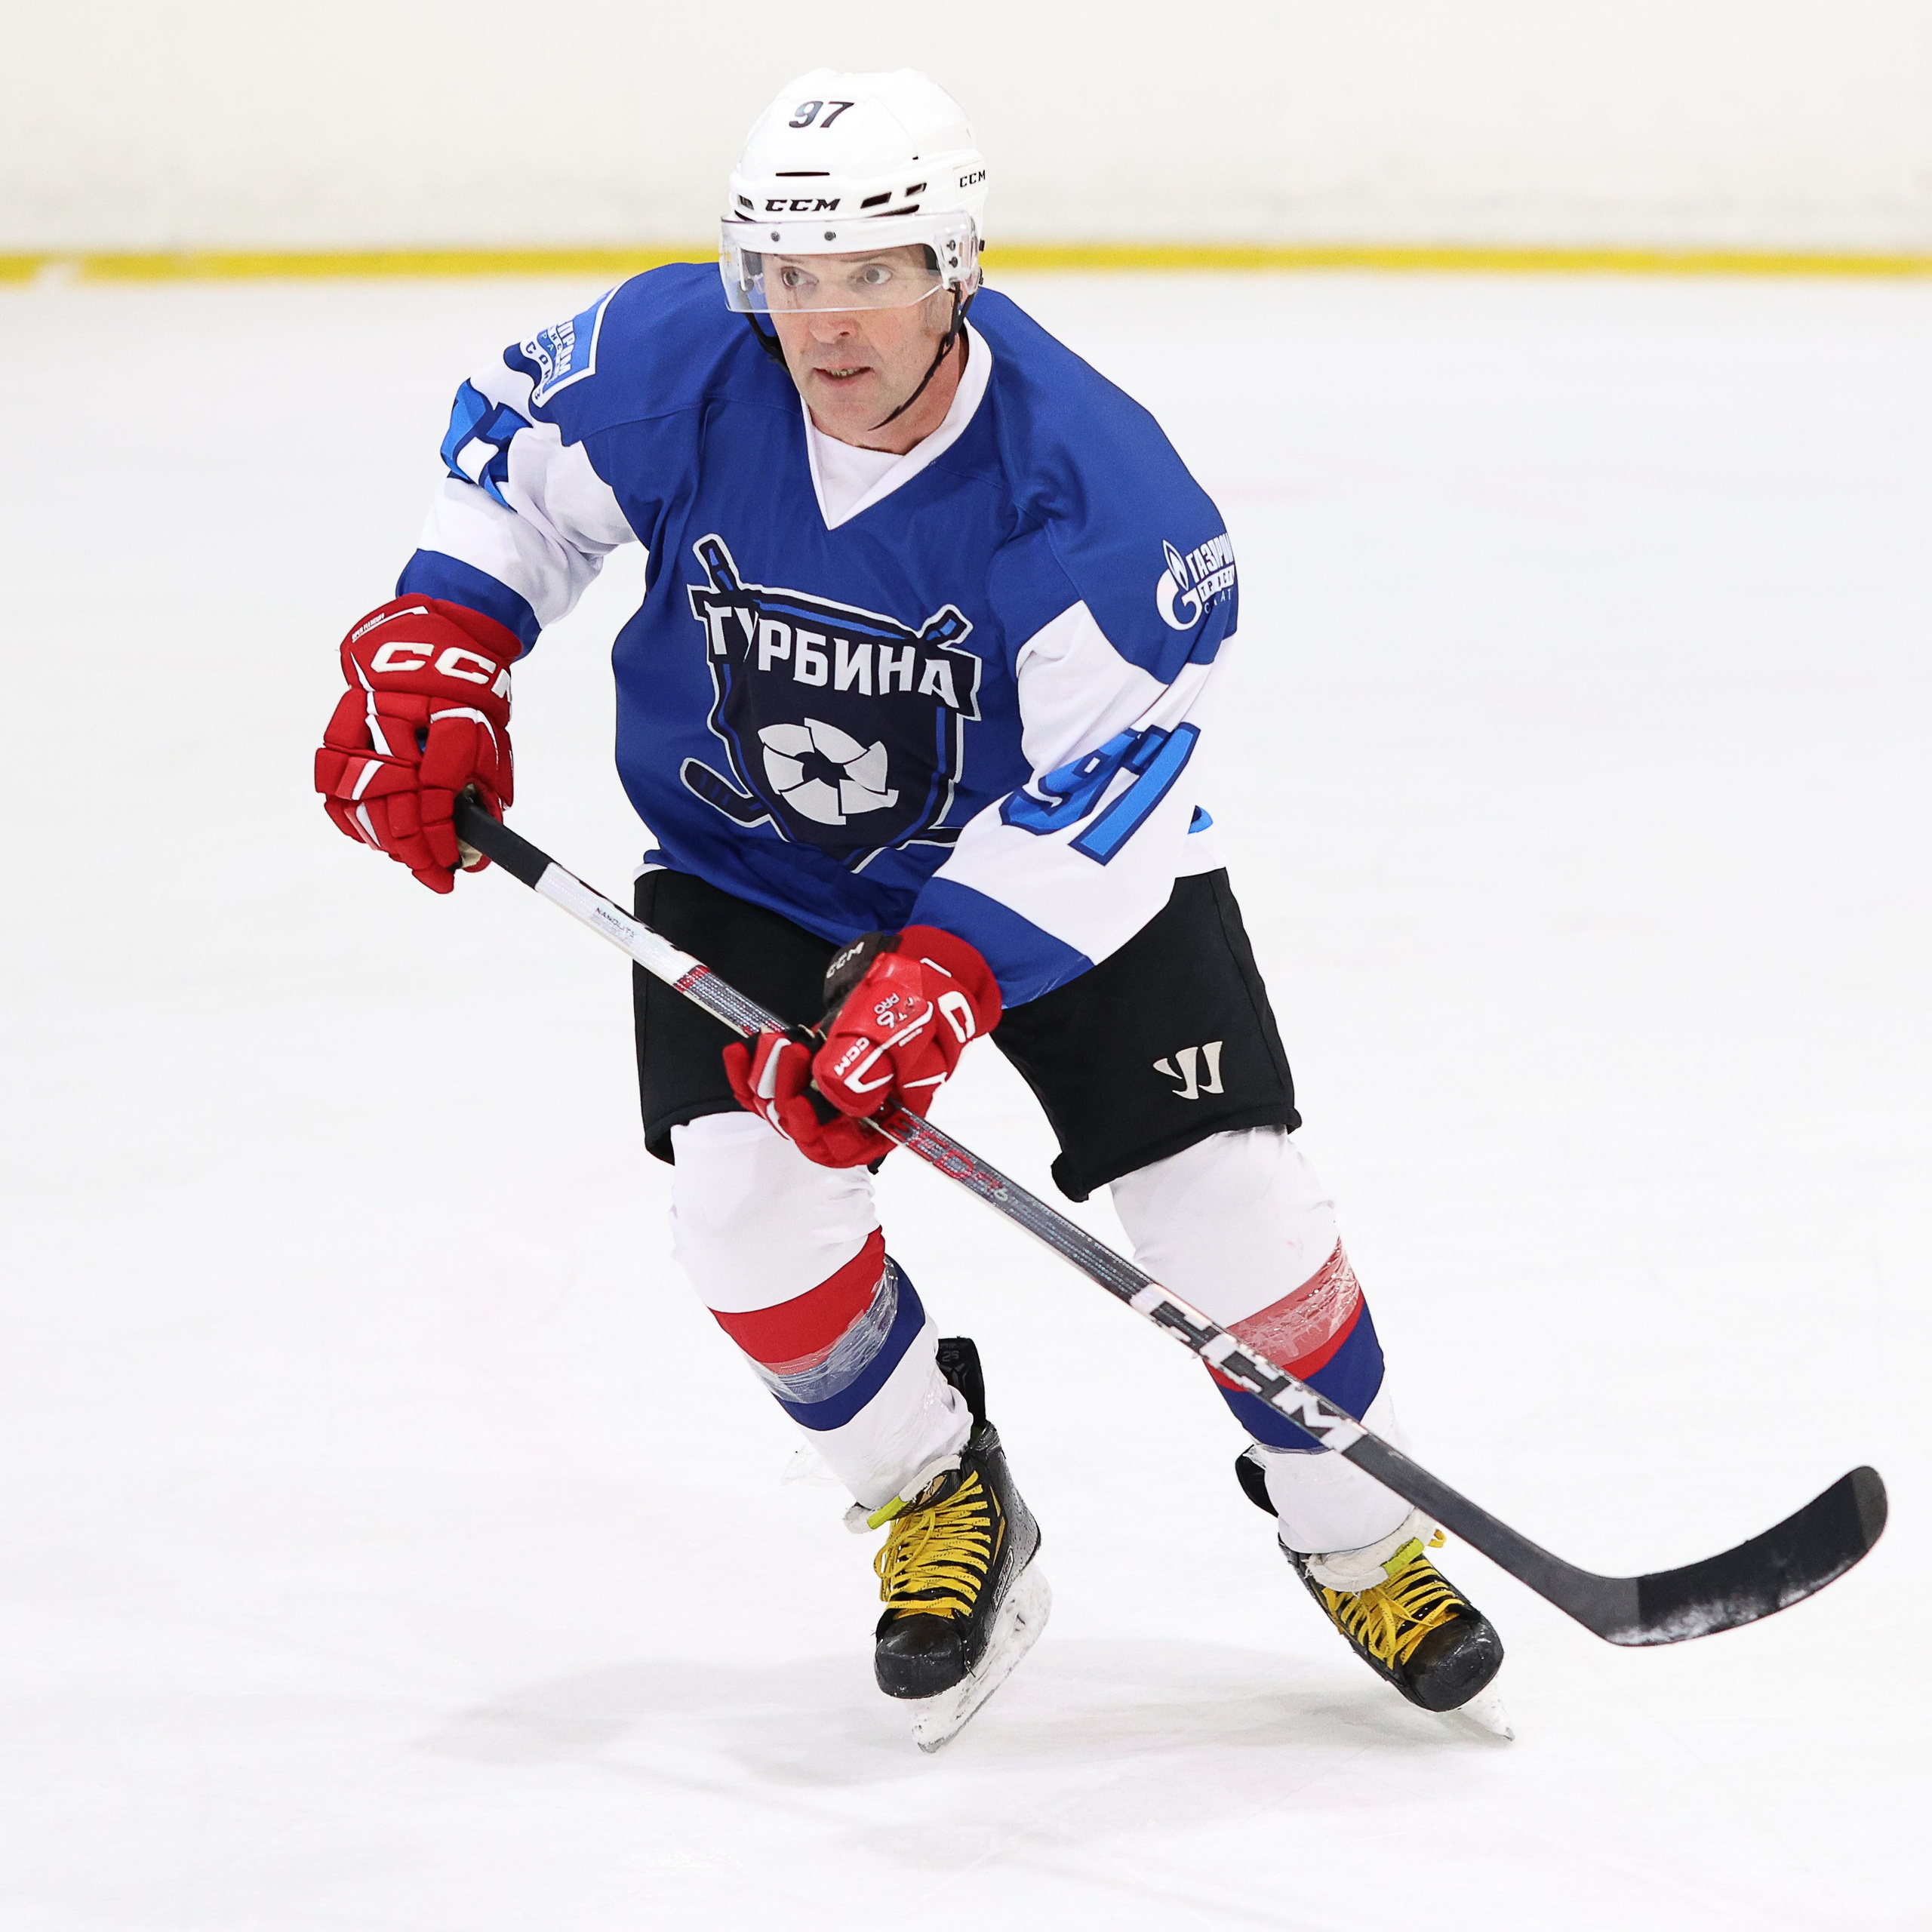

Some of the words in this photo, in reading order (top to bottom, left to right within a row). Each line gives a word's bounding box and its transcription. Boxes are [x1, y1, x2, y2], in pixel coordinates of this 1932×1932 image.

[789, 100, 855, 128] 97
[959, 170, 986, 188] CCM
[764, 198, 841, 211] CCM
[704, 601, 960, 709] ТУРБИНА
[998, 721, 1201, 866] 97
[826, 942, 865, 979] CCM
[873, 992, 900, 1015] PRO
[833, 1037, 870, 1077] CCM
[1130, 1282, 1368, 1454] CCM
